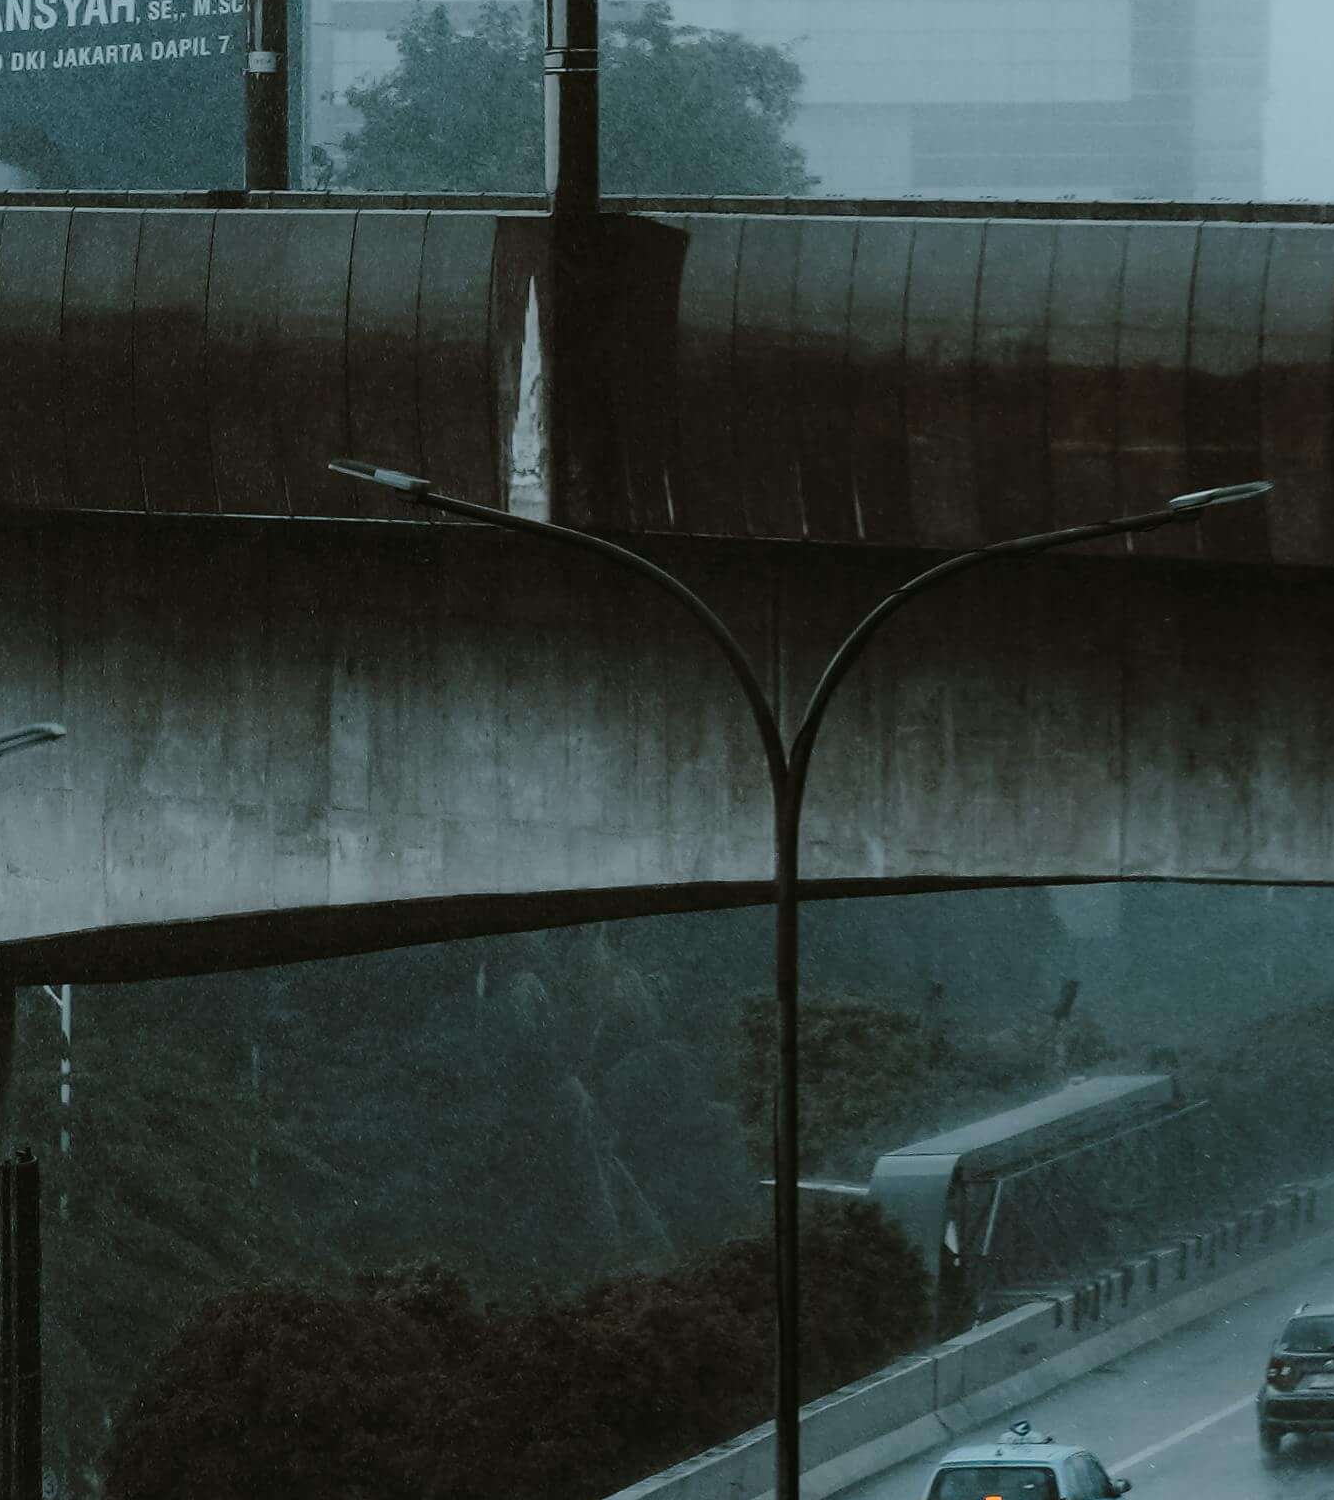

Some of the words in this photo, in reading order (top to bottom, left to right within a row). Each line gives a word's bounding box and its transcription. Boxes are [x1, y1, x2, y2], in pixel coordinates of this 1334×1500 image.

[10, 50, 46, 71] DKI
[53, 43, 144, 69] JAKARTA
[151, 37, 211, 61] DAPIL
[218, 35, 231, 54] 7
